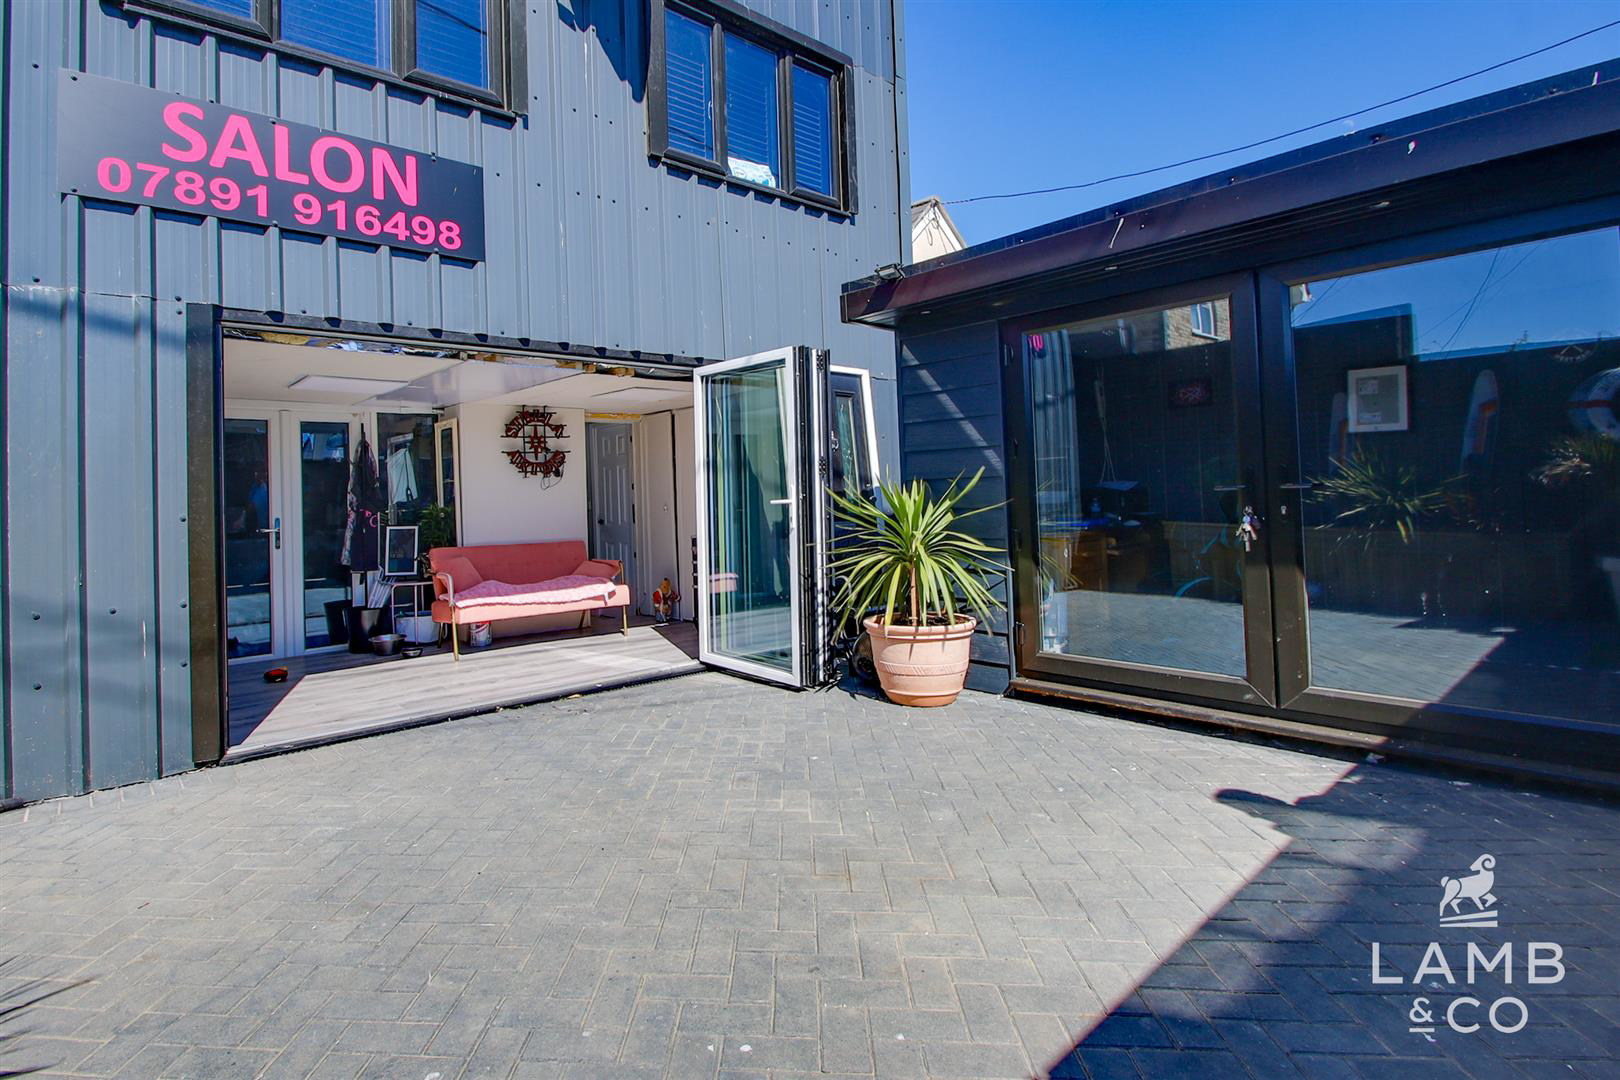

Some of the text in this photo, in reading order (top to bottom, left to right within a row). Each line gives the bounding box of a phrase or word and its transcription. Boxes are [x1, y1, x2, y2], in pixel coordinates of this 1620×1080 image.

[97, 157, 462, 250] 07891 916498
[161, 101, 418, 207] SALON
